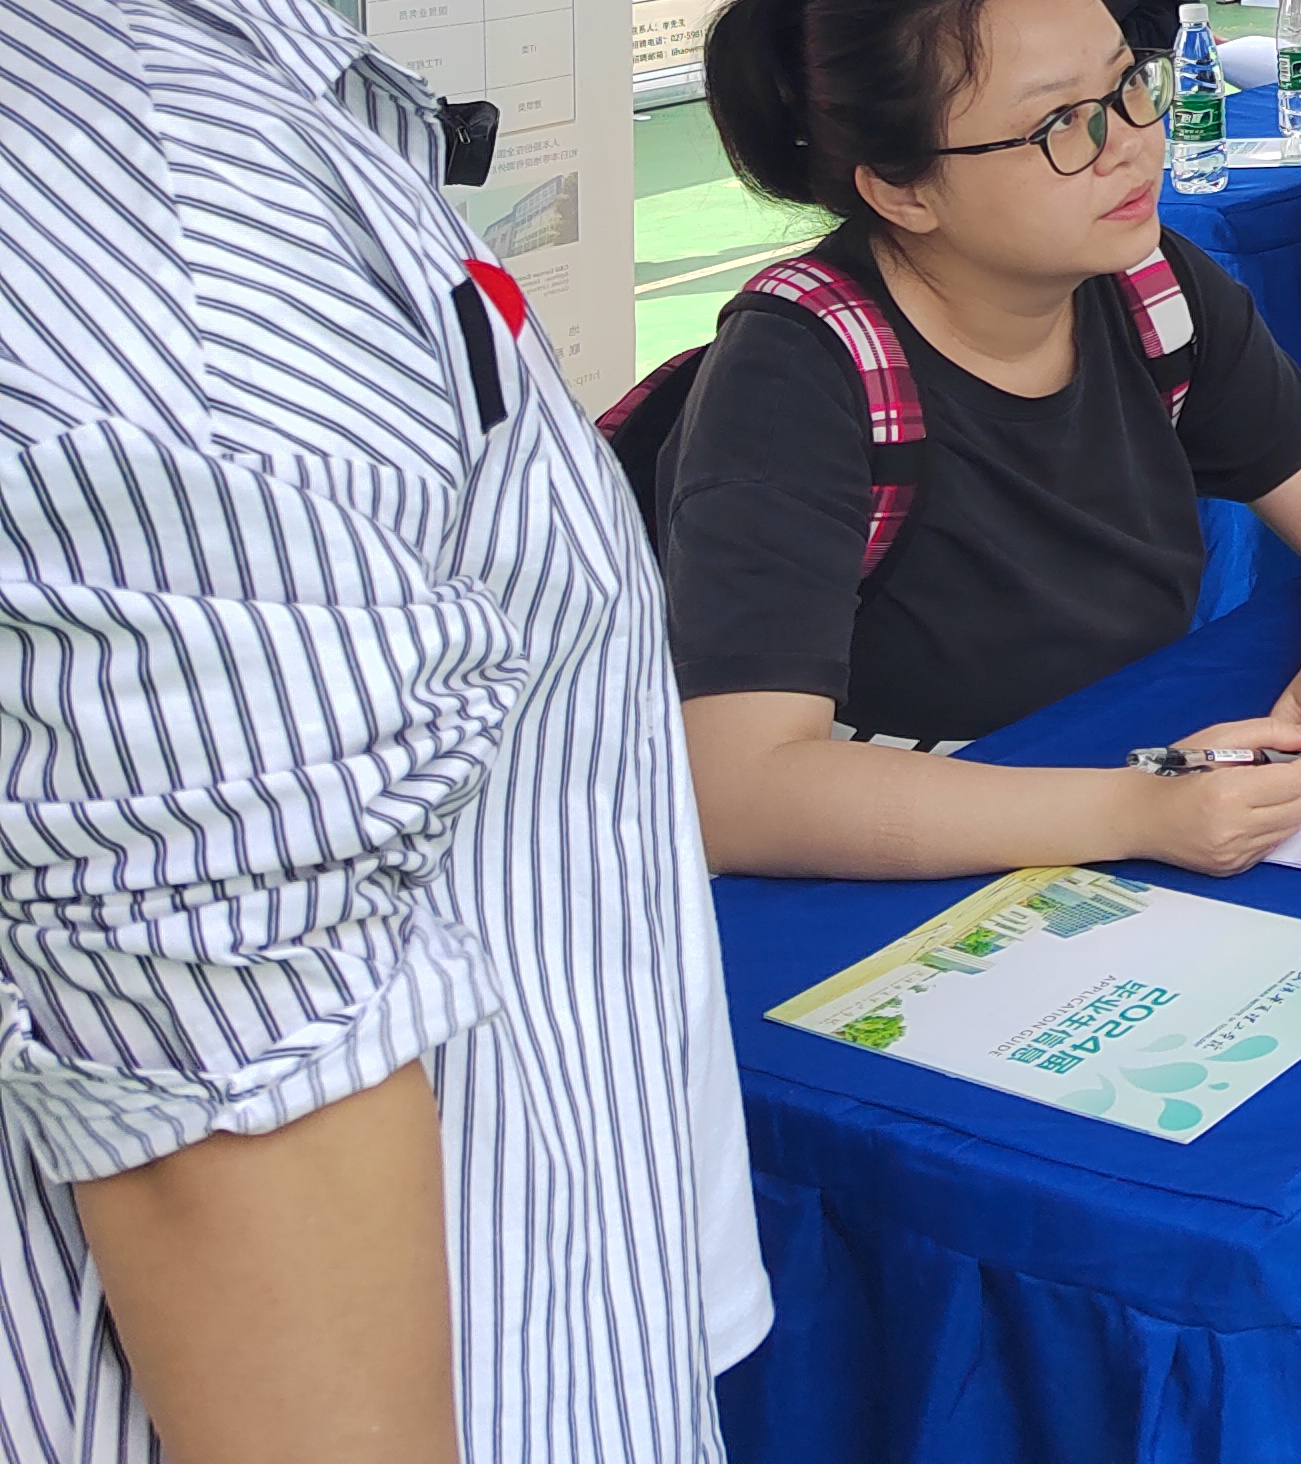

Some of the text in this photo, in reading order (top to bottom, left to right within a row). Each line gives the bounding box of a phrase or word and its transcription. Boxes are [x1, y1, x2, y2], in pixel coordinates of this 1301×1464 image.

[988, 974, 1117, 1057] APPLICATION GUIDE
[1007, 979, 1149, 1064] 毕业生信息
[1034, 987, 1181, 1074] 2024届
